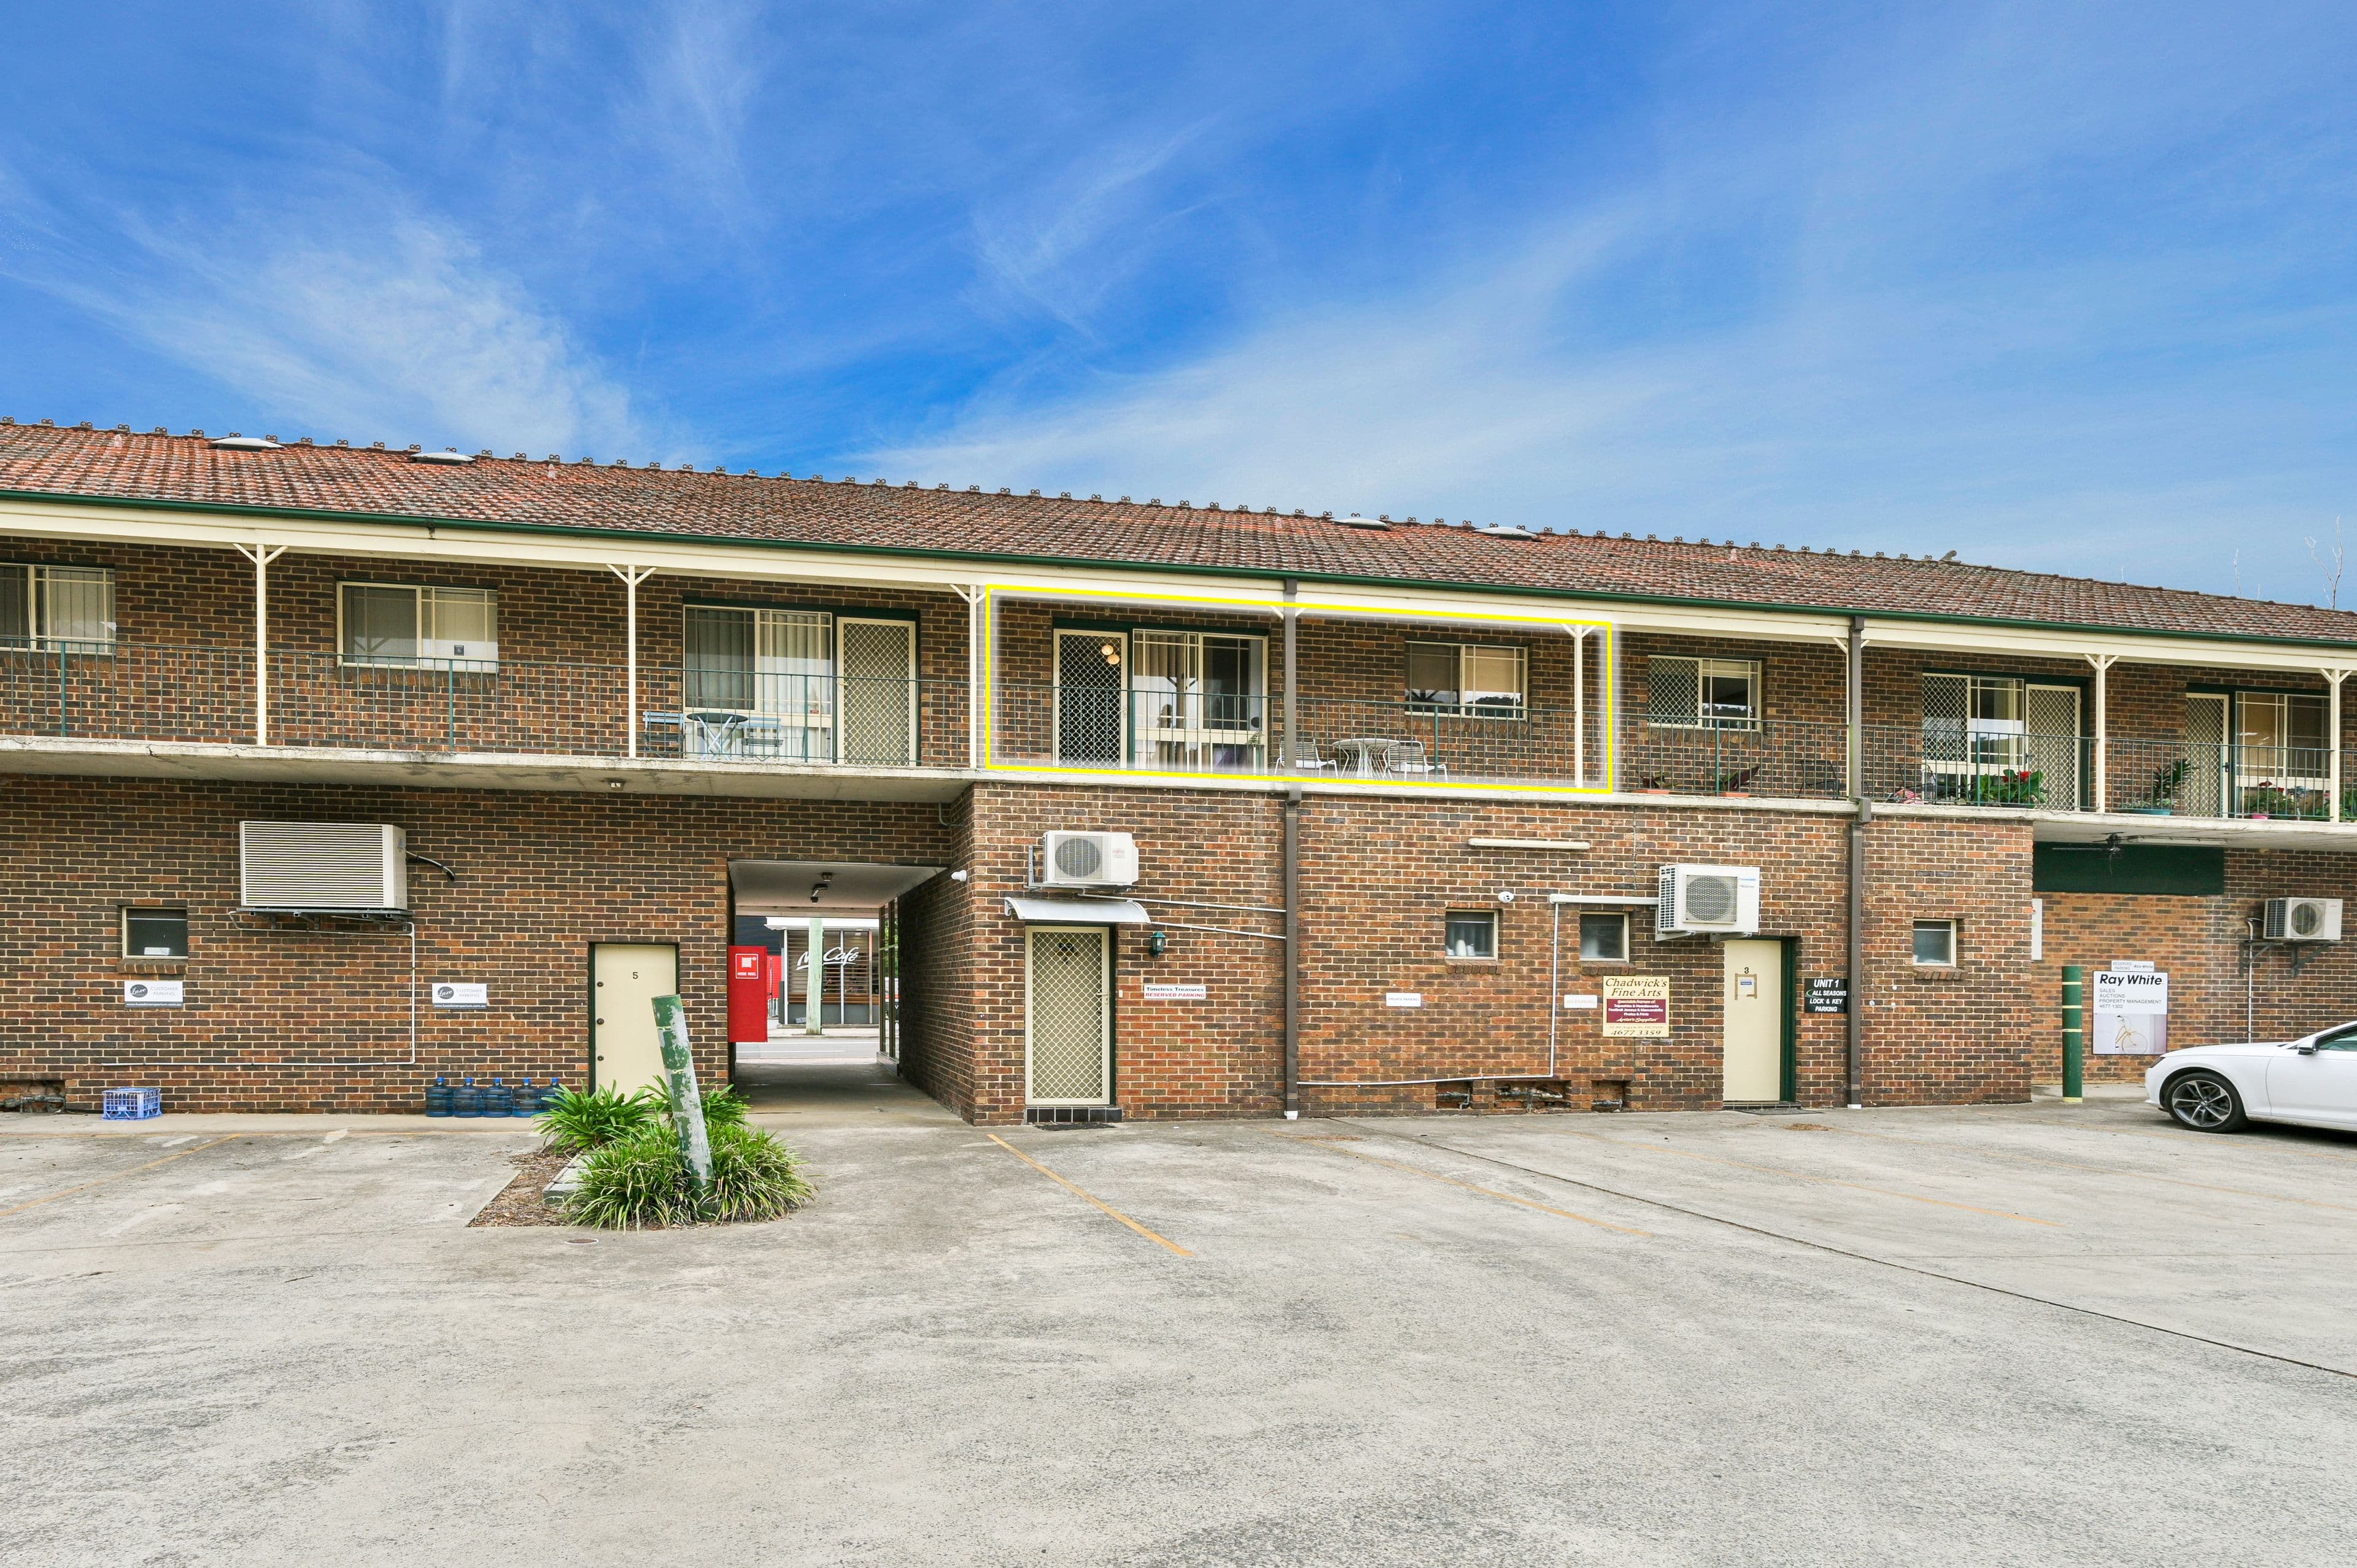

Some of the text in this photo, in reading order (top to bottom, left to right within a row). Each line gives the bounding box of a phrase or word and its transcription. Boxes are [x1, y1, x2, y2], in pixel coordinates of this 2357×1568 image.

[797, 947, 859, 967] MCafé
[1606, 978, 1667, 987] Chadwick's
[1814, 979, 1840, 988] UNIT 1
[2100, 974, 2162, 986] Ray White
[1638, 988, 1662, 997] Arts
